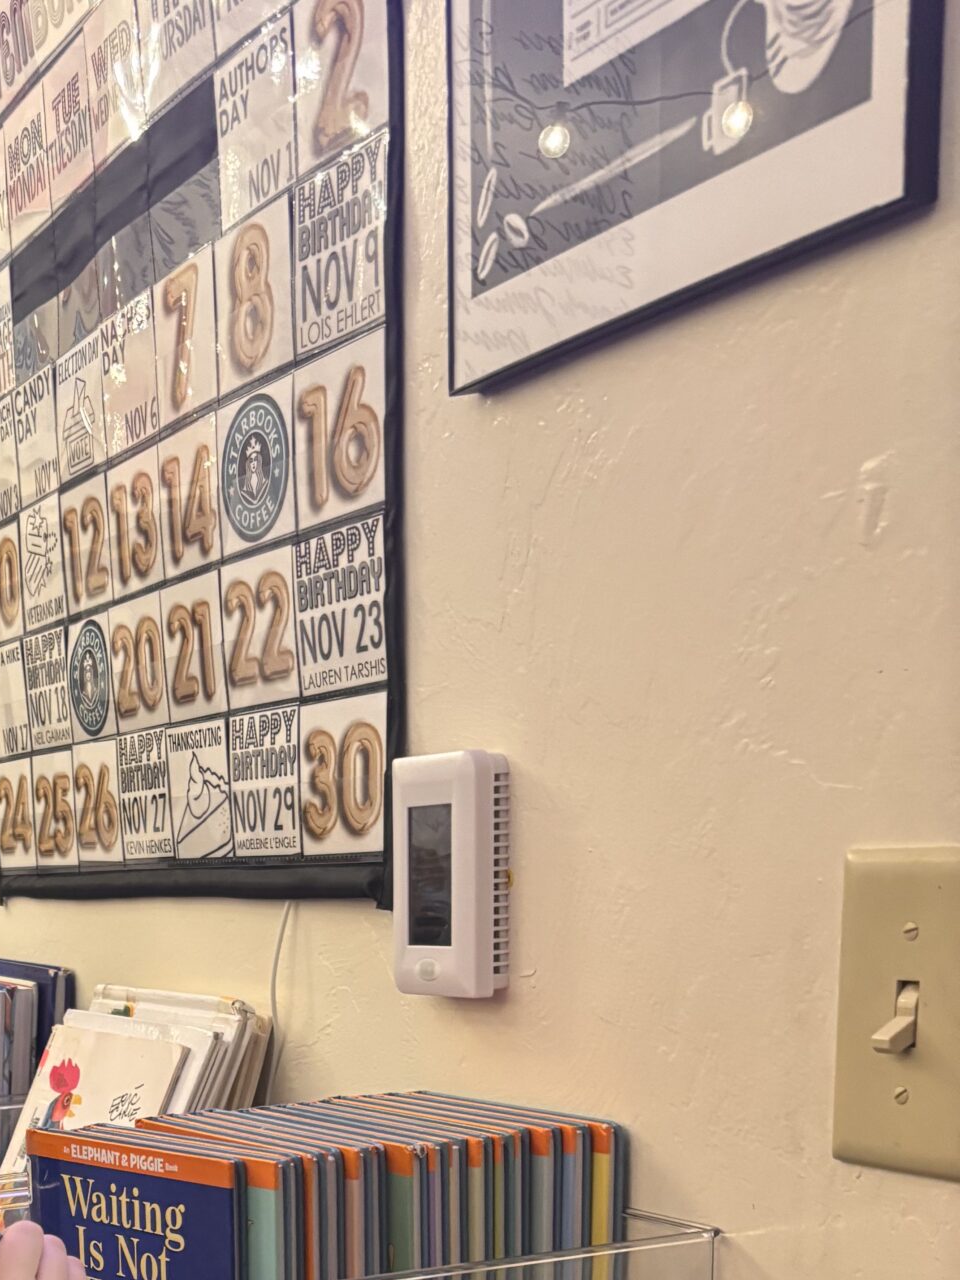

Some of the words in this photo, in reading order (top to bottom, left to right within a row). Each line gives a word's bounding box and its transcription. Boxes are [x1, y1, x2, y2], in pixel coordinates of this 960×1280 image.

[91, 20, 132, 89] WED
[219, 27, 289, 108] AUTHORS
[311, 0, 370, 158] 2
[52, 72, 80, 138] TUE
[220, 90, 250, 138] DAY
[7, 112, 44, 181] MON
[49, 104, 90, 180] TUESDAY
[9, 154, 46, 219] MONDAY
[249, 148, 280, 208] NOV
[298, 138, 383, 224] HAPPY
[298, 180, 383, 262] BIRTHDAY
[231, 221, 275, 371] 8
[302, 240, 360, 323] NOV
[365, 226, 380, 288] 9
[164, 261, 199, 412] 7
[300, 319, 332, 349] LOIS
[336, 289, 382, 334] EHLERT
[58, 348, 90, 386] ELECTION
[88, 335, 100, 364] DAY
[102, 340, 126, 376] DAY
[14, 367, 50, 415] CANDY
[0, 424, 12, 444] DAY
[16, 409, 37, 445] DAY
[68, 435, 90, 465] VOTE
[124, 403, 149, 445] NOV
[150, 397, 158, 430] 6
[228, 408, 281, 475] STARBOOKS
[298, 368, 382, 509] 16
[34, 464, 50, 497] NOV
[162, 443, 216, 562] 14
[110, 472, 158, 585] 13
[234, 496, 275, 529] COFFEE
[63, 495, 109, 605] 12
[295, 518, 381, 579] HAPPY
[27, 602, 53, 625] VETERANS
[53, 597, 65, 618] DAY
[296, 556, 384, 614] BIRTHDAY
[6, 646, 21, 665] HIKE
[24, 628, 63, 666] HAPPY
[168, 600, 218, 705] 21
[224, 571, 294, 687] 22
[299, 607, 346, 666] NOV
[352, 599, 383, 656] 23
[27, 656, 66, 692] BIRTHDAY
[111, 615, 163, 718] 20
[303, 669, 343, 691] LAUREN
[344, 657, 386, 682] TARSHIS
[29, 688, 52, 729] NOV
[54, 685, 69, 724] 18
[231, 709, 296, 751] HAPPY
[2, 732, 20, 755] NOV
[20, 722, 29, 751] 17
[119, 730, 164, 766] HAPPY
[168, 734, 222, 753] THANKSGIVING
[232, 744, 297, 782] BIRTHDAY
[75, 763, 119, 851] 26
[121, 761, 167, 794] BIRTHDAY
[303, 721, 384, 840] 30
[35, 771, 74, 858] 25
[122, 797, 149, 835] NOV
[152, 793, 167, 833] 27
[234, 792, 271, 833] NOV
[273, 785, 296, 831] 29
[126, 840, 145, 855] KEVIN
[145, 838, 172, 854] HENKES
[71, 1143, 120, 1167] ELEPHANT
[121, 1157, 128, 1168] &
[130, 1154, 164, 1173] PIGGIE
[165, 1163, 178, 1172] Book
[60, 1173, 186, 1252] Waiting
[75, 1225, 104, 1271] Is
